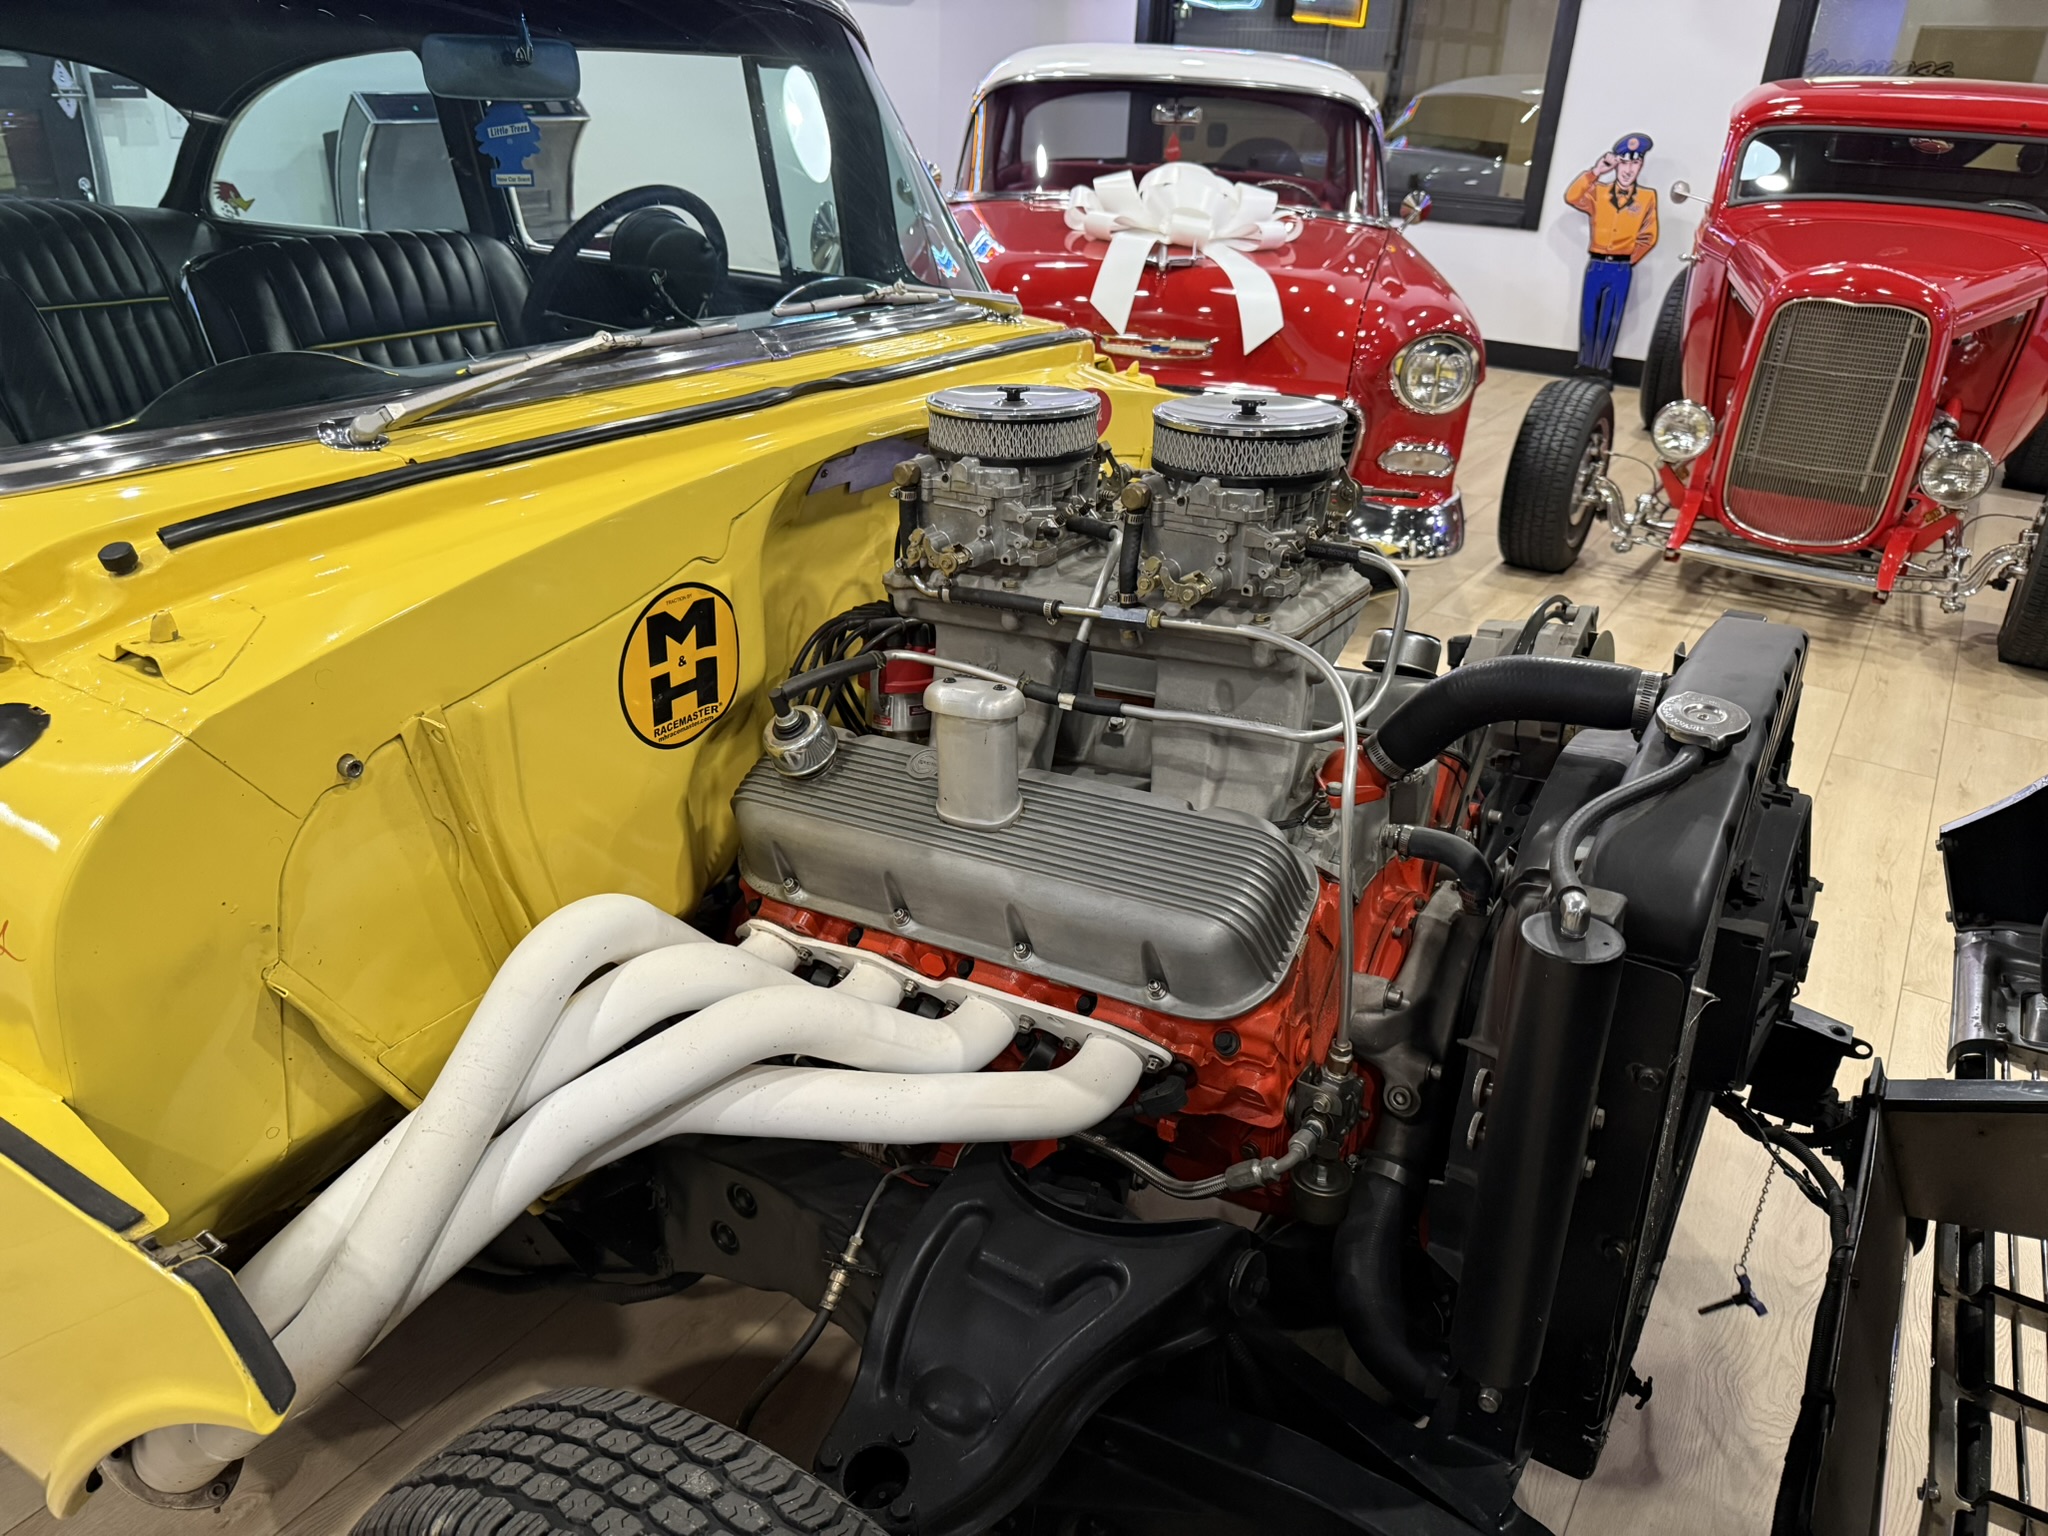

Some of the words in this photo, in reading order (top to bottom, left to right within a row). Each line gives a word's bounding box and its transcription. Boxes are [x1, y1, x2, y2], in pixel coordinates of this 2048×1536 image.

[490, 126, 508, 137] Little
[510, 125, 528, 134] Trees
[666, 595, 686, 606] TRACTION
[646, 597, 716, 668] M
[678, 656, 687, 667] &
[650, 655, 719, 727] H
[658, 715, 715, 743] mhracemaster.com
